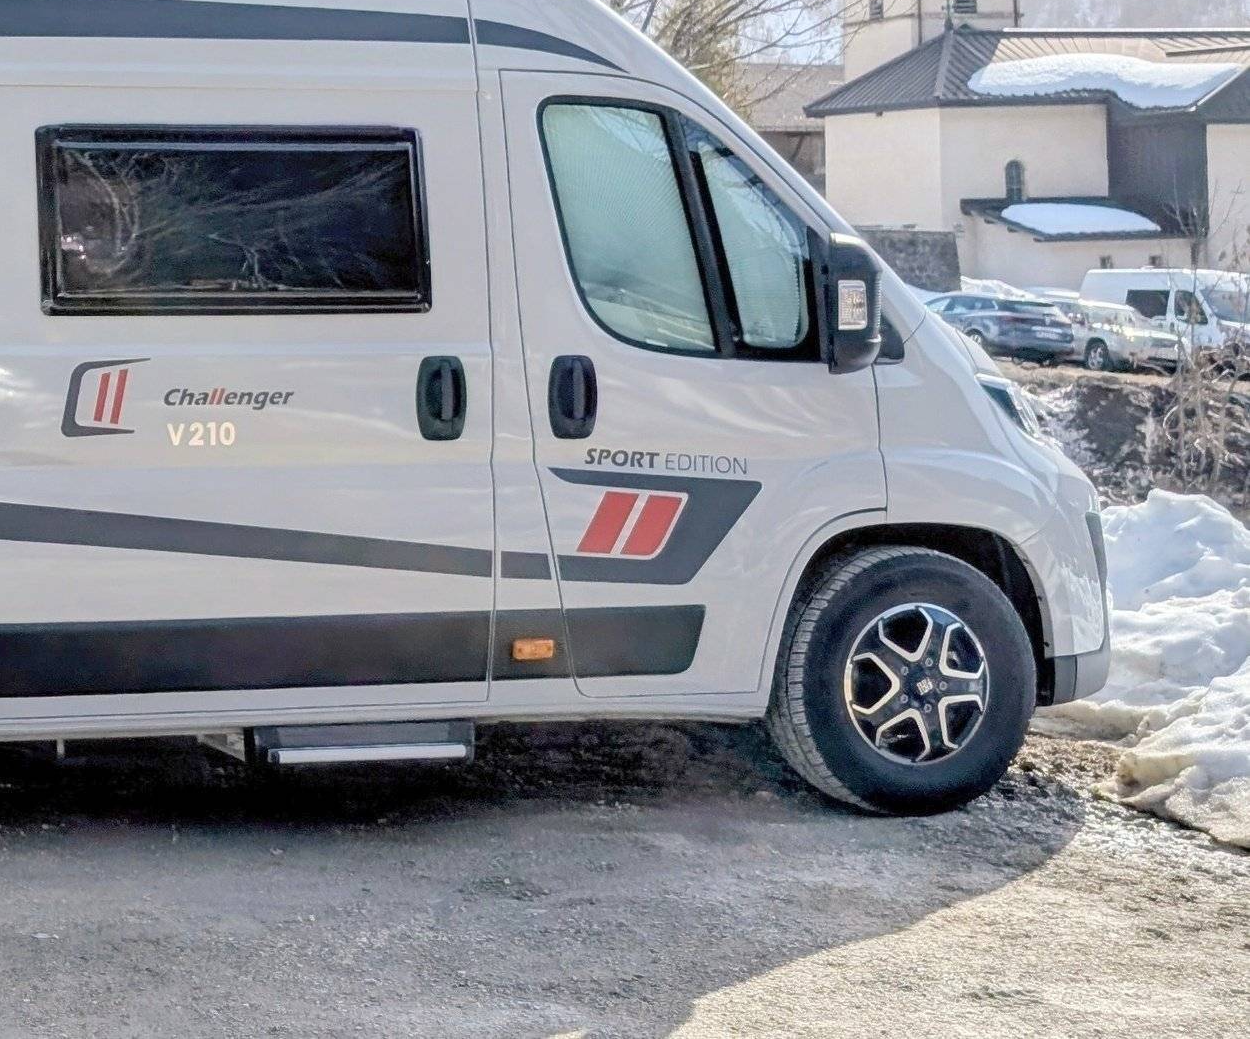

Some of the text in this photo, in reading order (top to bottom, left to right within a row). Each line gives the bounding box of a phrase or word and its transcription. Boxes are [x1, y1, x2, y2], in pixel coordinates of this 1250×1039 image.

[164, 387, 294, 410] Challenger
[584, 448, 750, 474] SPORT EDITION
